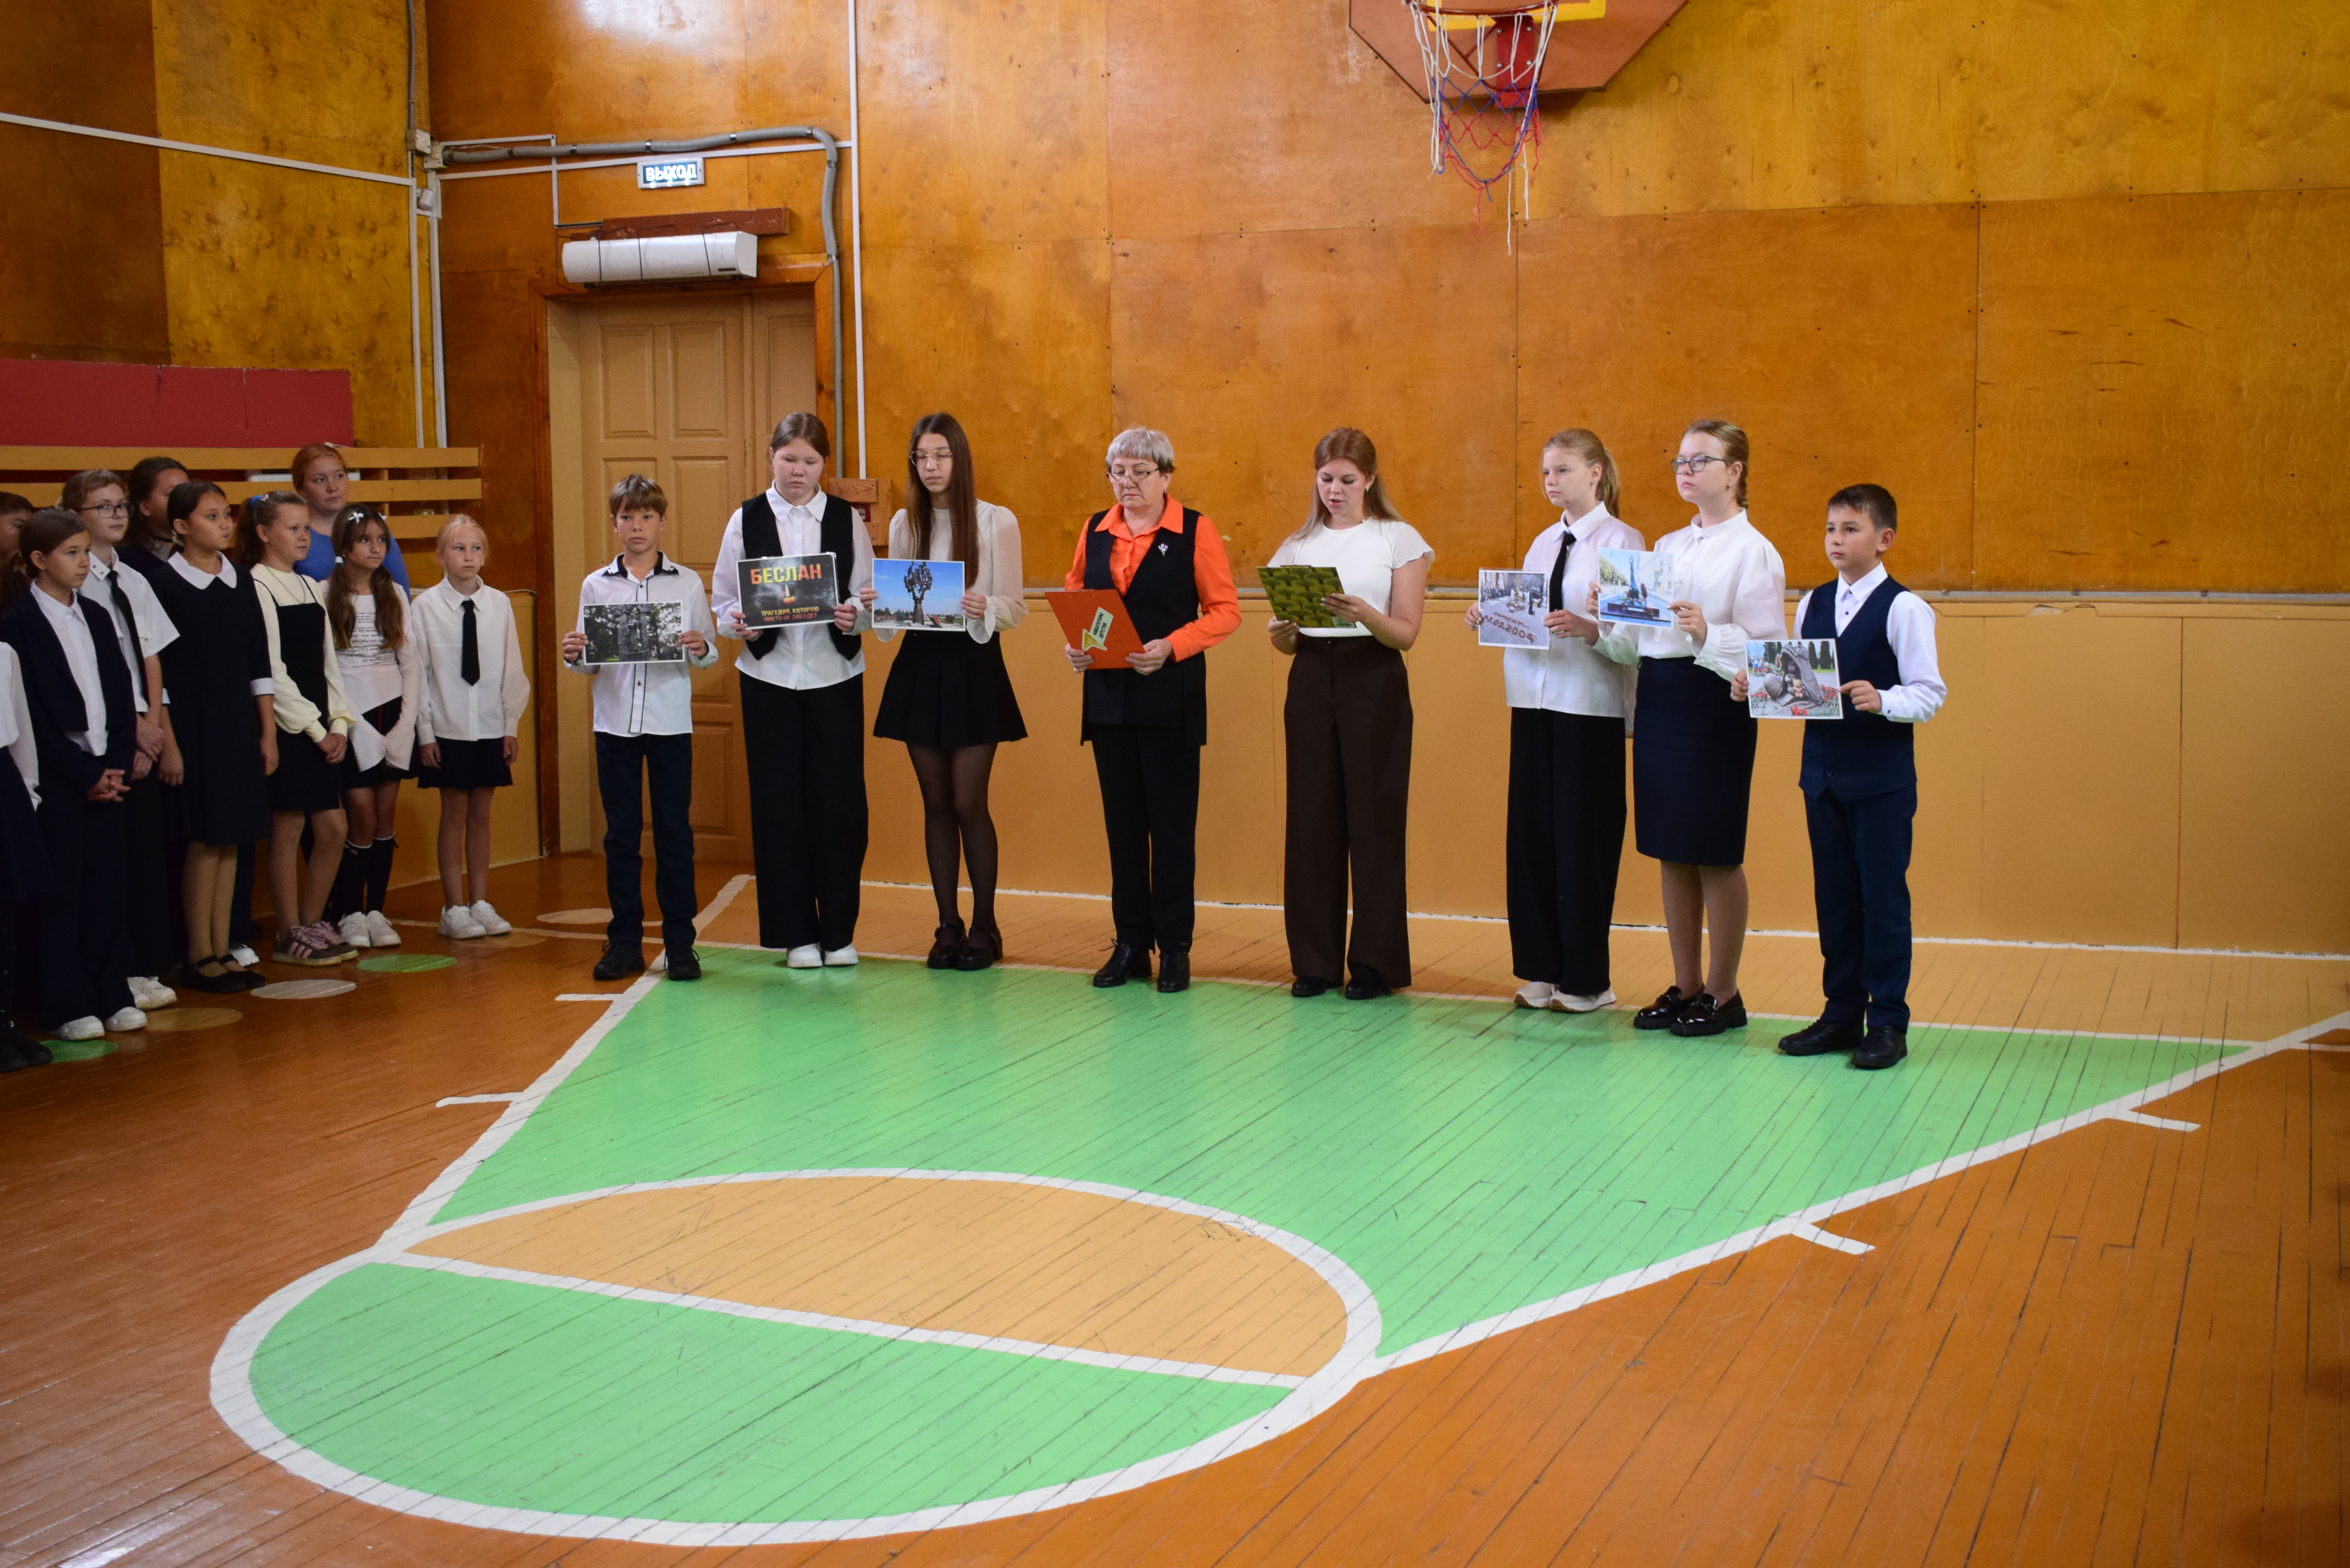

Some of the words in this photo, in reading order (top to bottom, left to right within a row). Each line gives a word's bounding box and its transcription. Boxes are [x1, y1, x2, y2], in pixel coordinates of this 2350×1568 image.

[646, 164, 697, 182] ВЫХОД
[750, 564, 821, 584] БЕСЛАН
[1099, 622, 1107, 639] ДЕТСТВА
